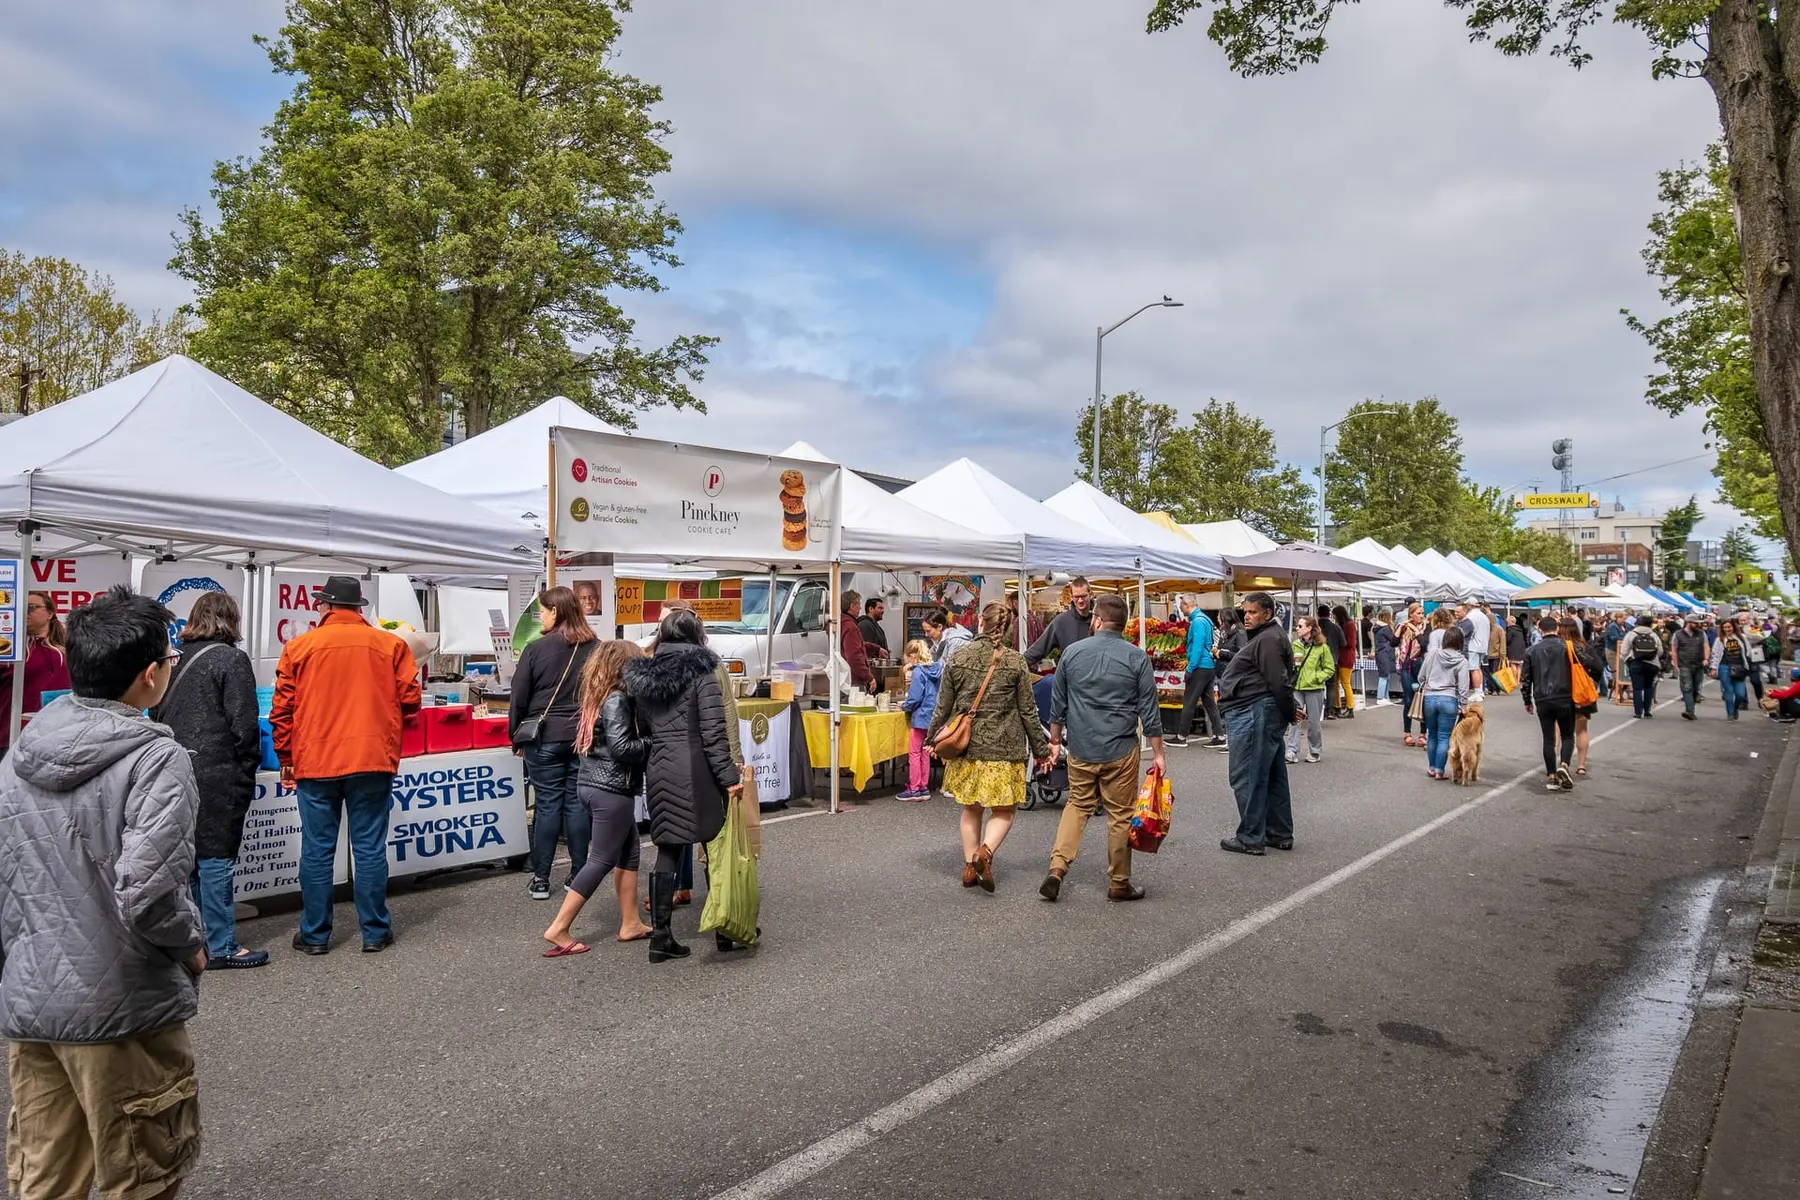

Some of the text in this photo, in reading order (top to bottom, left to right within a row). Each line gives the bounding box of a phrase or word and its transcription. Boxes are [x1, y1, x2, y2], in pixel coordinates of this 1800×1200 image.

[591, 463, 622, 474] Traditional
[591, 475, 638, 487] Artisan Cookies
[1529, 496, 1583, 505] CROSSWALK
[592, 502, 610, 512] Vegan
[616, 504, 647, 514] gluten-free
[680, 499, 742, 529] Pinckney
[592, 513, 614, 523] Miracle
[614, 515, 638, 525] Cookies
[687, 525, 713, 535] COOKIE
[30, 559, 77, 583] VE
[617, 587, 639, 600] GOT
[772, 762, 778, 773] &
[392, 765, 494, 789] SMOKED
[764, 777, 780, 788] free
[249, 806, 297, 816] (Dungeness
[245, 819, 276, 829] Clam
[394, 811, 499, 839] SMOKED
[264, 825, 303, 838] Halibu
[243, 840, 286, 853] Salmon
[388, 825, 506, 862] TUNA
[245, 851, 284, 865] Oyster
[233, 860, 298, 877] oked Tuna
[243, 881, 269, 893] One
